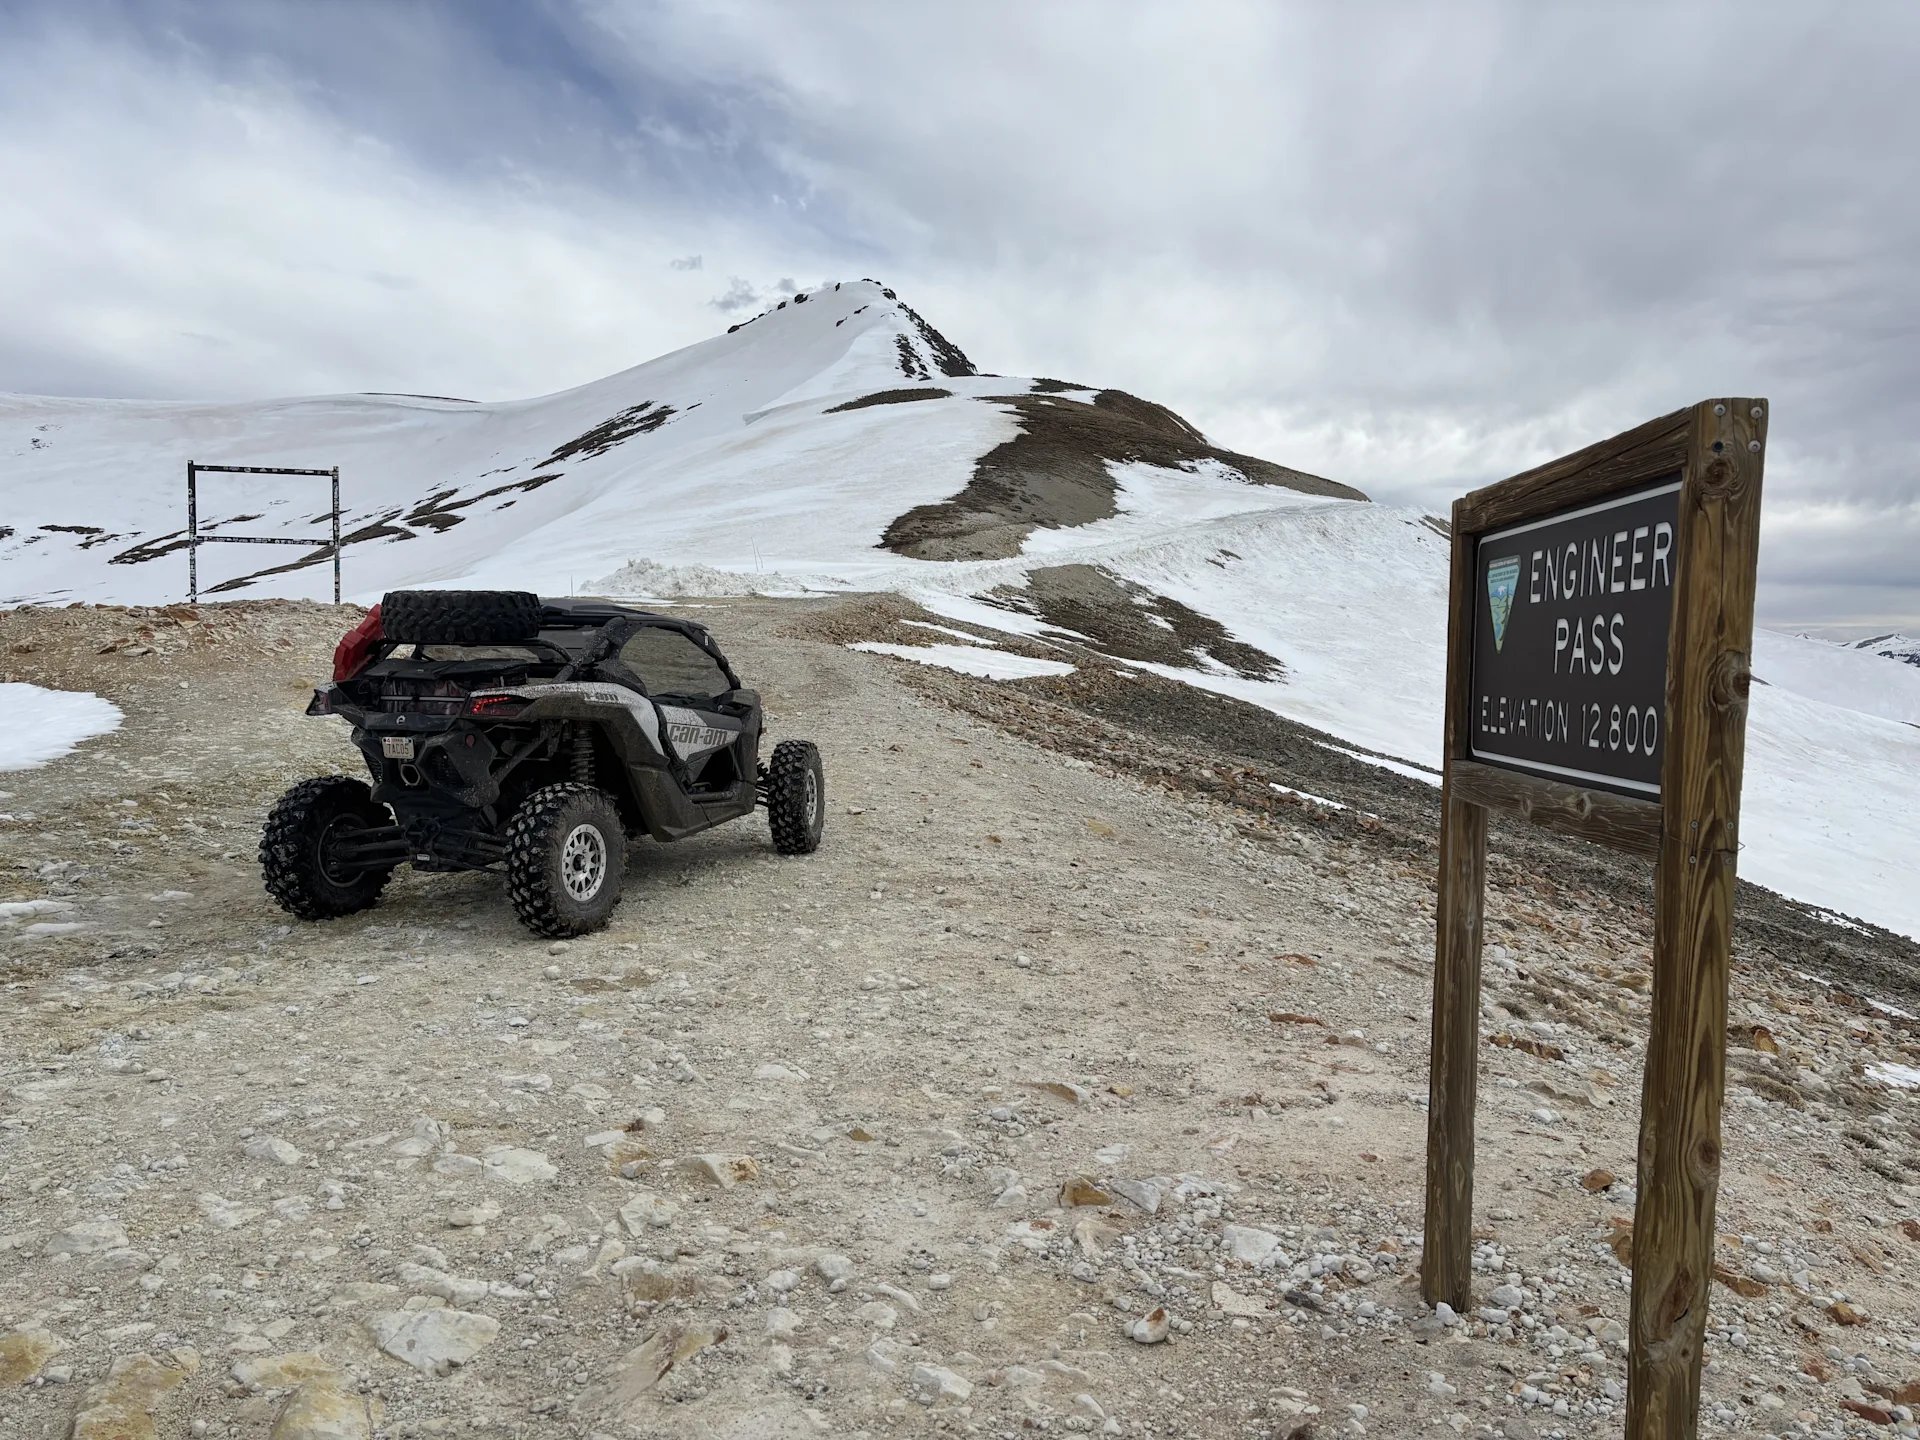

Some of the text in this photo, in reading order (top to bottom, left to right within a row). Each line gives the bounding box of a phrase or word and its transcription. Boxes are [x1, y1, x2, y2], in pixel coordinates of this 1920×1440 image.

[1529, 521, 1673, 604] ENGINEER
[1554, 612, 1625, 675] PASS
[669, 725, 728, 745] can-am
[1481, 695, 1569, 744] ELEVATION
